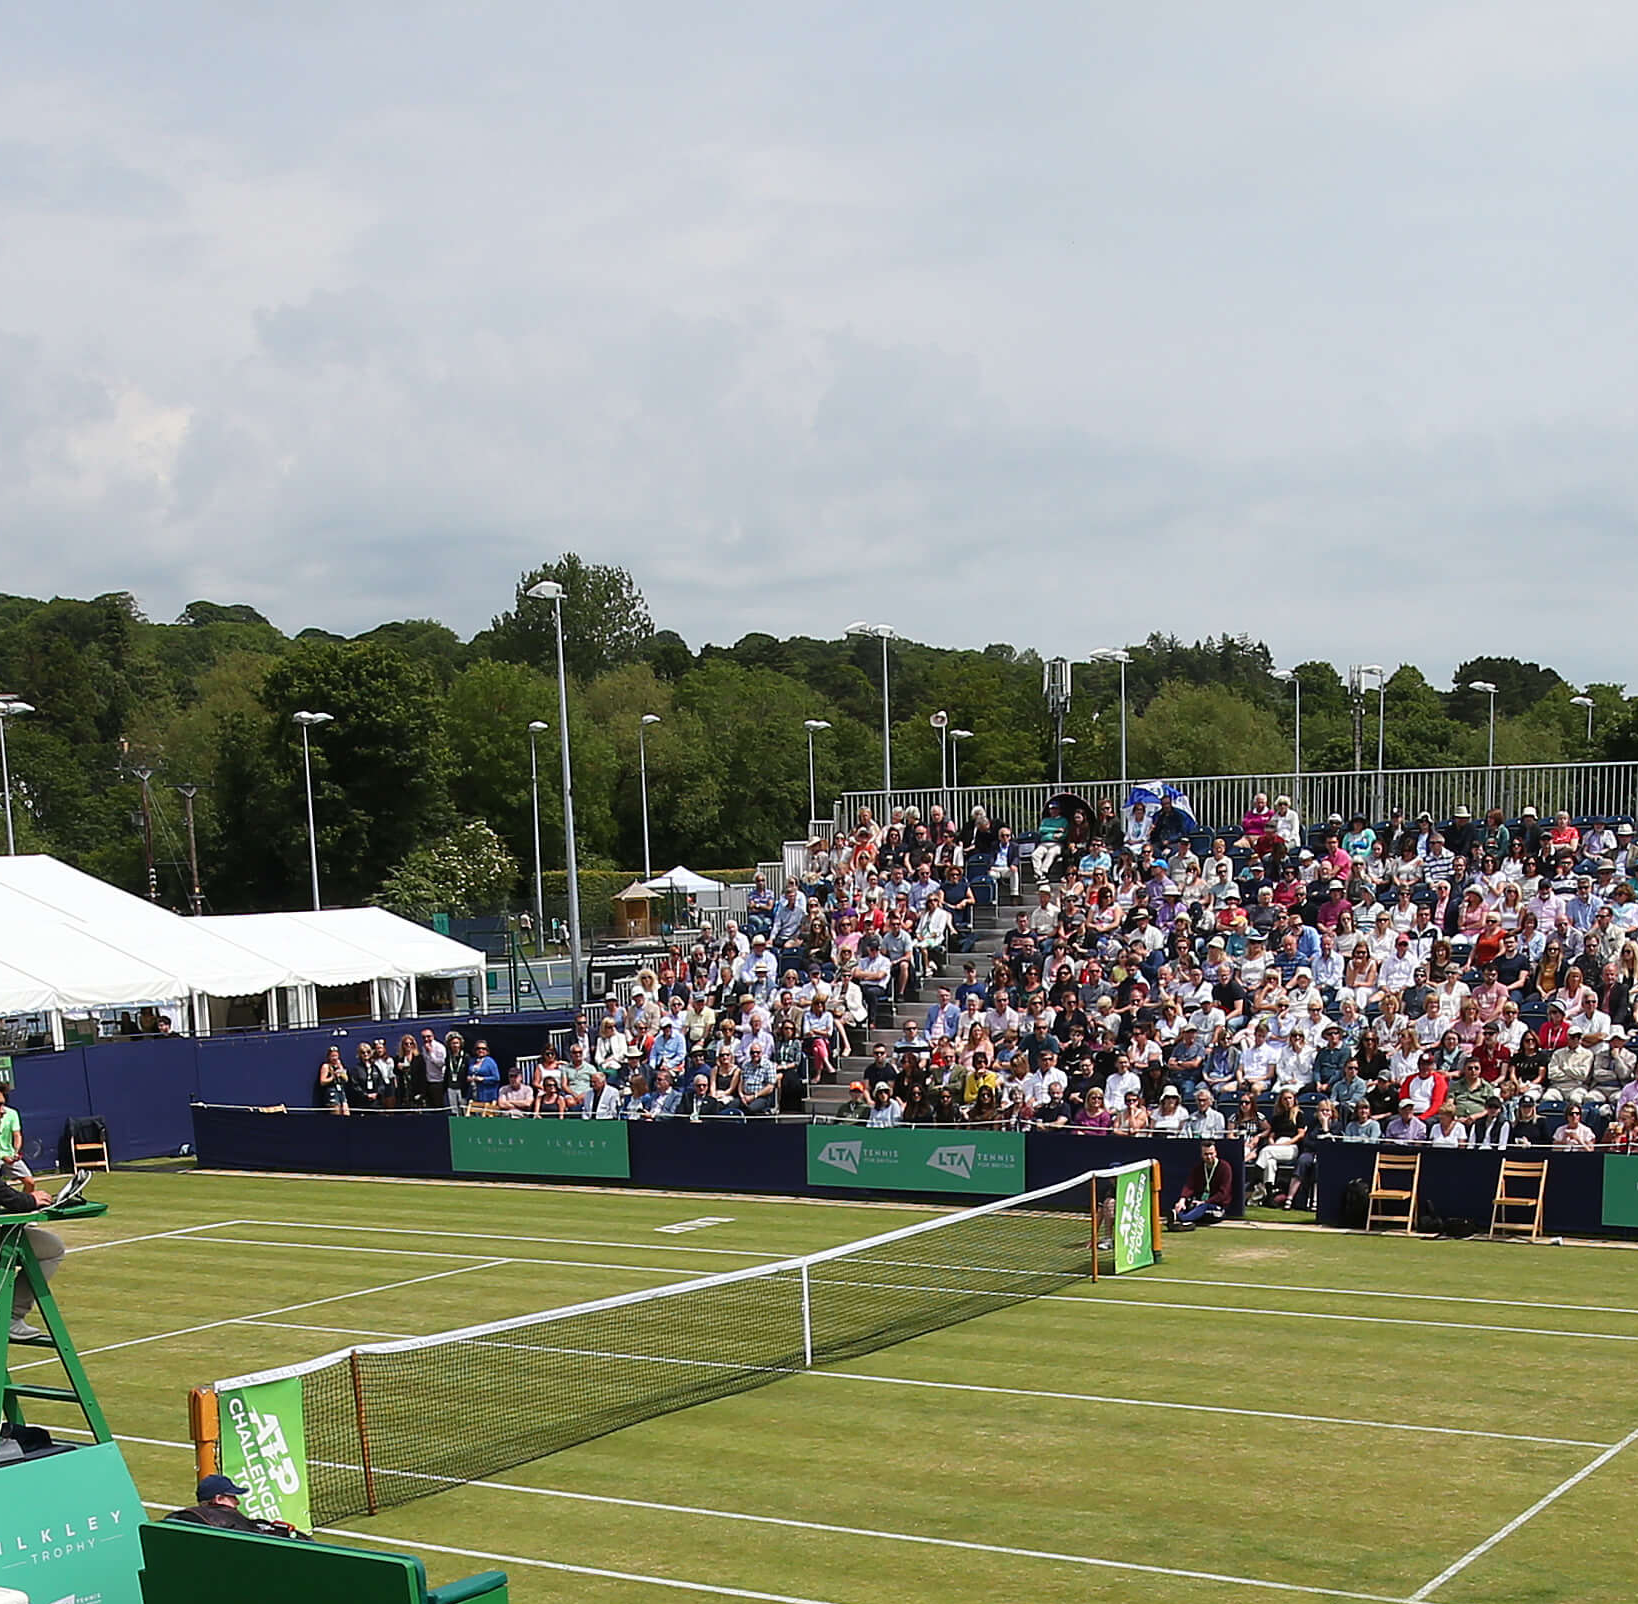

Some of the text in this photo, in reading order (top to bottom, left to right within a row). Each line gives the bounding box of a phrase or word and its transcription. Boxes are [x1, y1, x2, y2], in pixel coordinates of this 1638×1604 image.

[828, 1147, 898, 1171] LTA TENNIS
[938, 1152, 1015, 1176] LTA TENNIS
[1120, 1182, 1135, 1246] ATP
[248, 1405, 300, 1495] ATP
[30, 1537, 97, 1565] TROPHY
